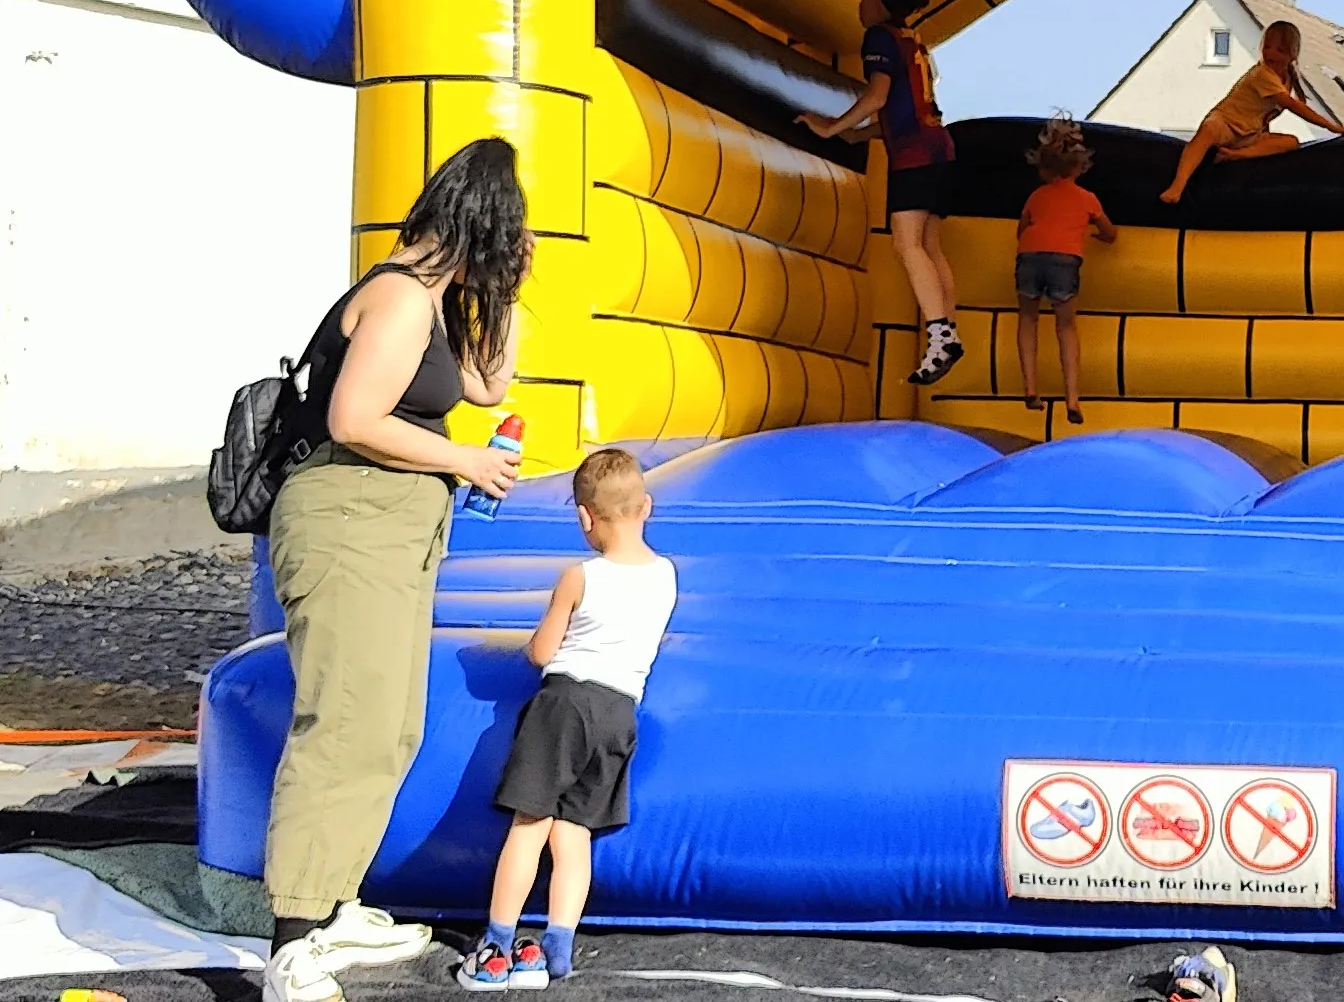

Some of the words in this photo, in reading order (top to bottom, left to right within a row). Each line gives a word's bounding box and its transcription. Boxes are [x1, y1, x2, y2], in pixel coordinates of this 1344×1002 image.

[1018, 872, 1080, 887] Eltern
[1087, 874, 1151, 889] haften
[1158, 876, 1187, 890] für
[1193, 877, 1232, 892] ihre
[1239, 879, 1308, 894] Kinder
